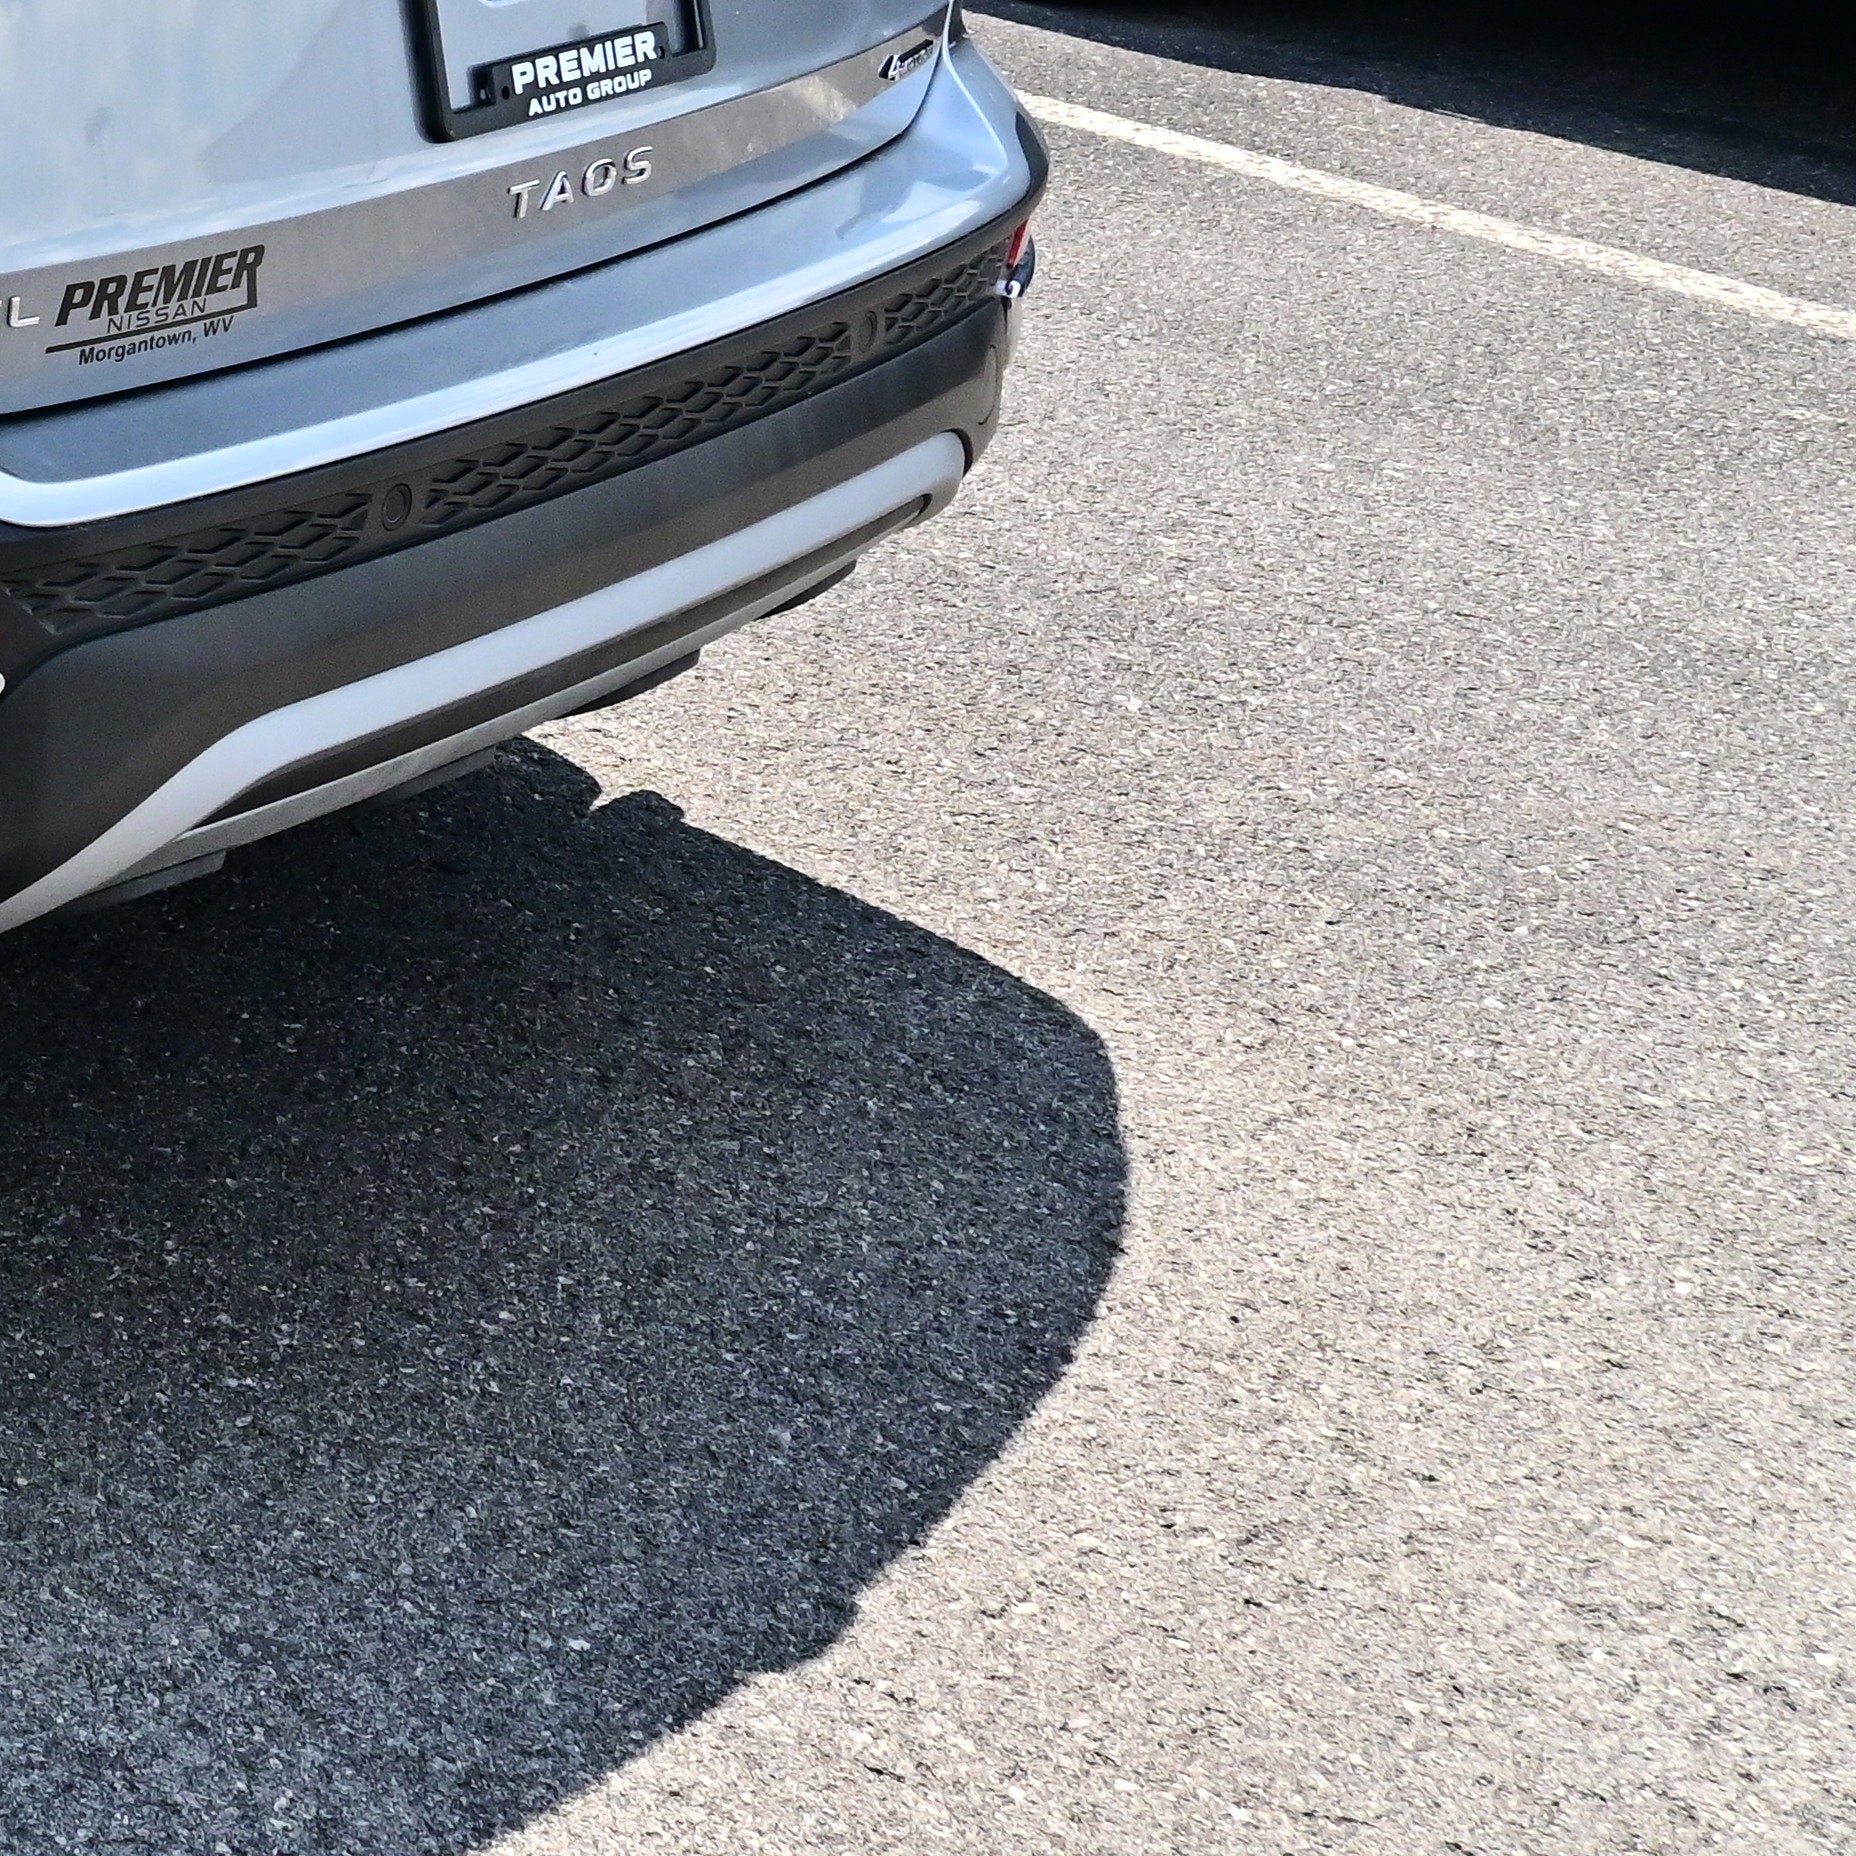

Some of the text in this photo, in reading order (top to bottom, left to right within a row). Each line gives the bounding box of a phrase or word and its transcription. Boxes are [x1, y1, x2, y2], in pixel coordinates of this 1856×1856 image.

[511, 30, 658, 95] PREMIER
[528, 70, 652, 117] AUTO GROUP
[507, 146, 654, 219] TAOS
[54, 244, 266, 327] PREMIER
[78, 315, 235, 366] Morgantown, WV
[106, 297, 208, 334] NISSAN
